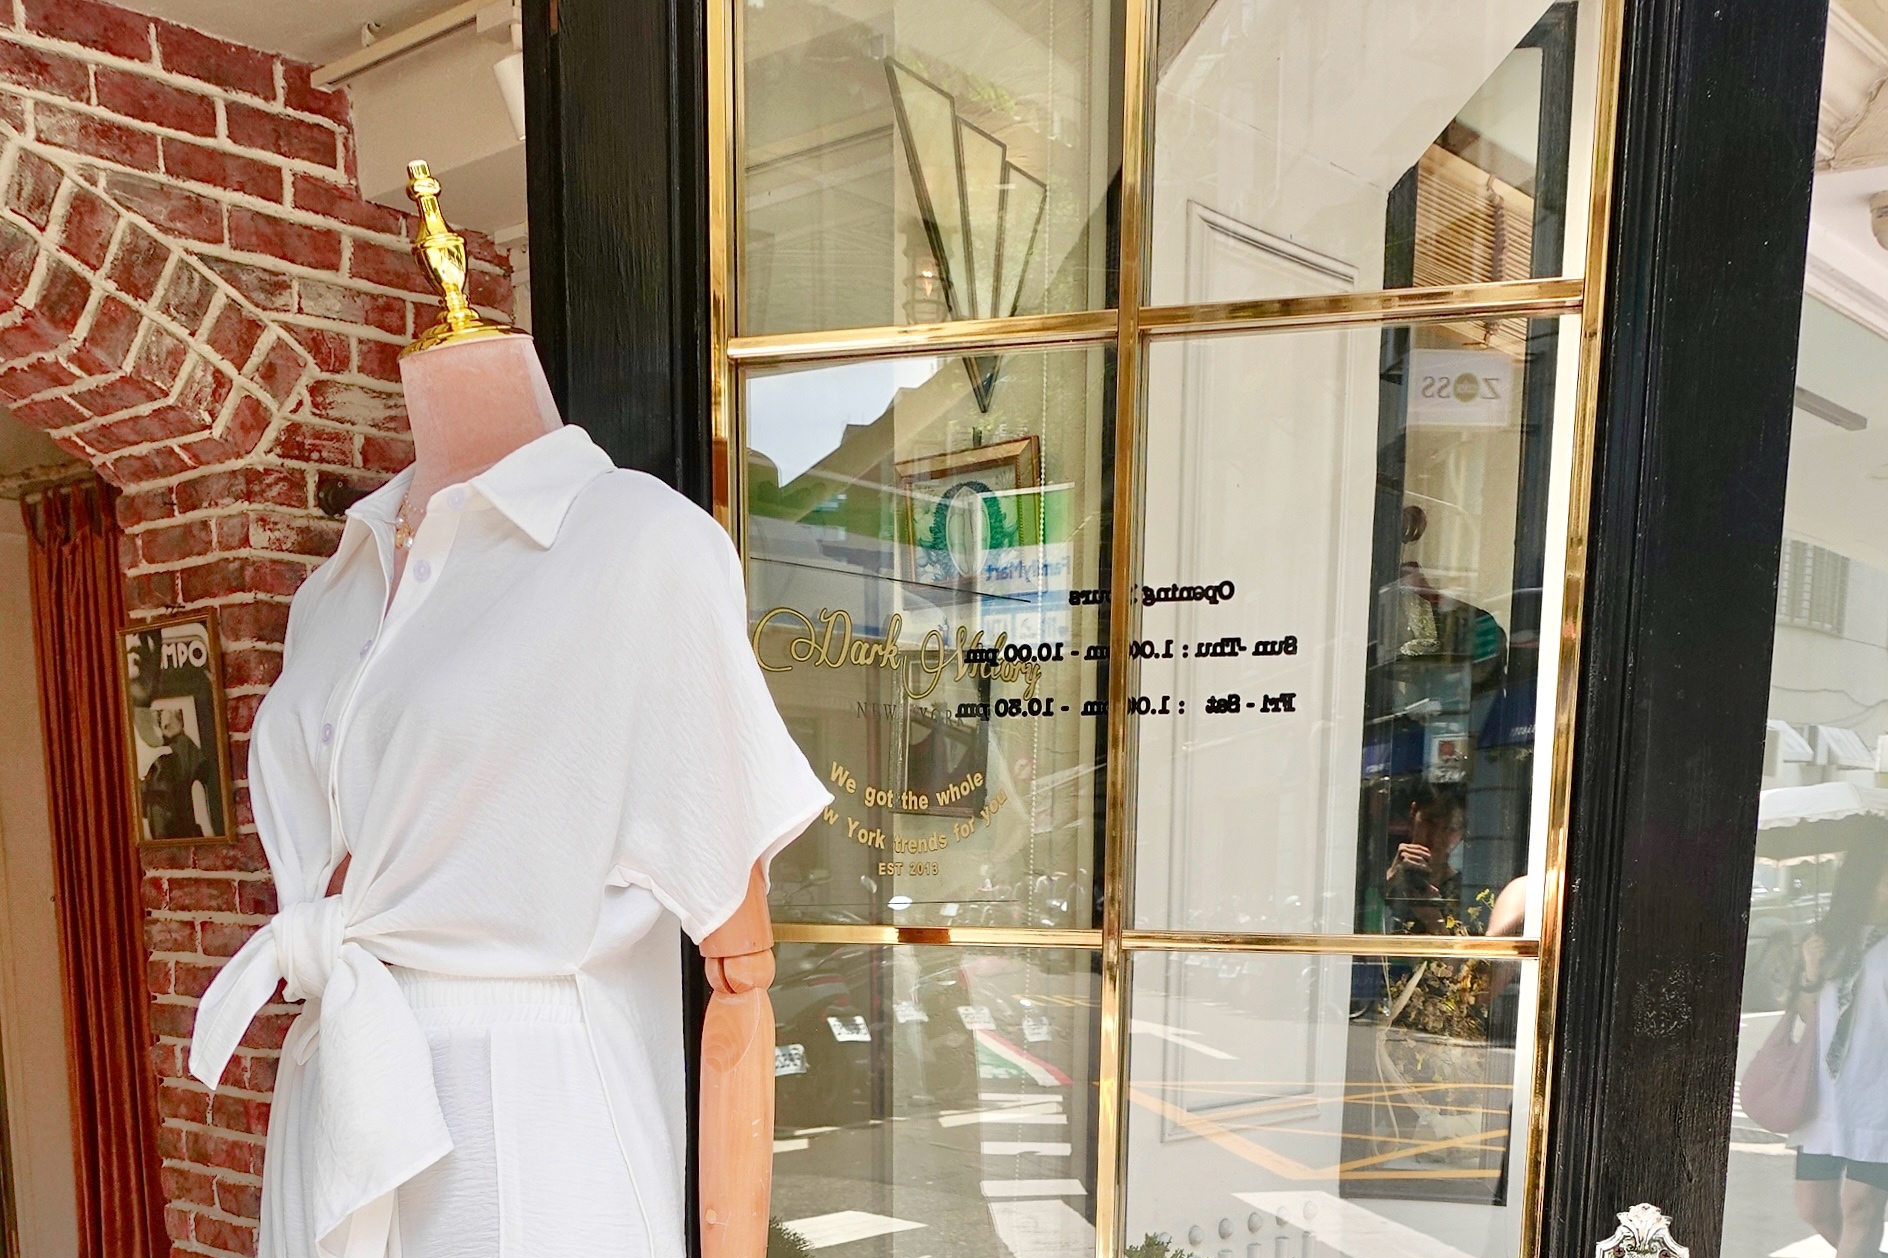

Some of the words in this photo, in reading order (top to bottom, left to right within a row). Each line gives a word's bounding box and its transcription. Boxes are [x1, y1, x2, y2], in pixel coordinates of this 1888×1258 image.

[753, 606, 903, 673] Dark
[856, 701, 897, 720] NEW
[830, 761, 857, 793] We
[864, 787, 894, 808] got
[901, 791, 929, 810] the
[935, 771, 984, 806] whole
[846, 817, 886, 850] York
[893, 831, 948, 854] trends
[953, 816, 976, 842] for
[979, 787, 1009, 827] you
[878, 862, 904, 876] EST
[908, 862, 940, 876] 2013
